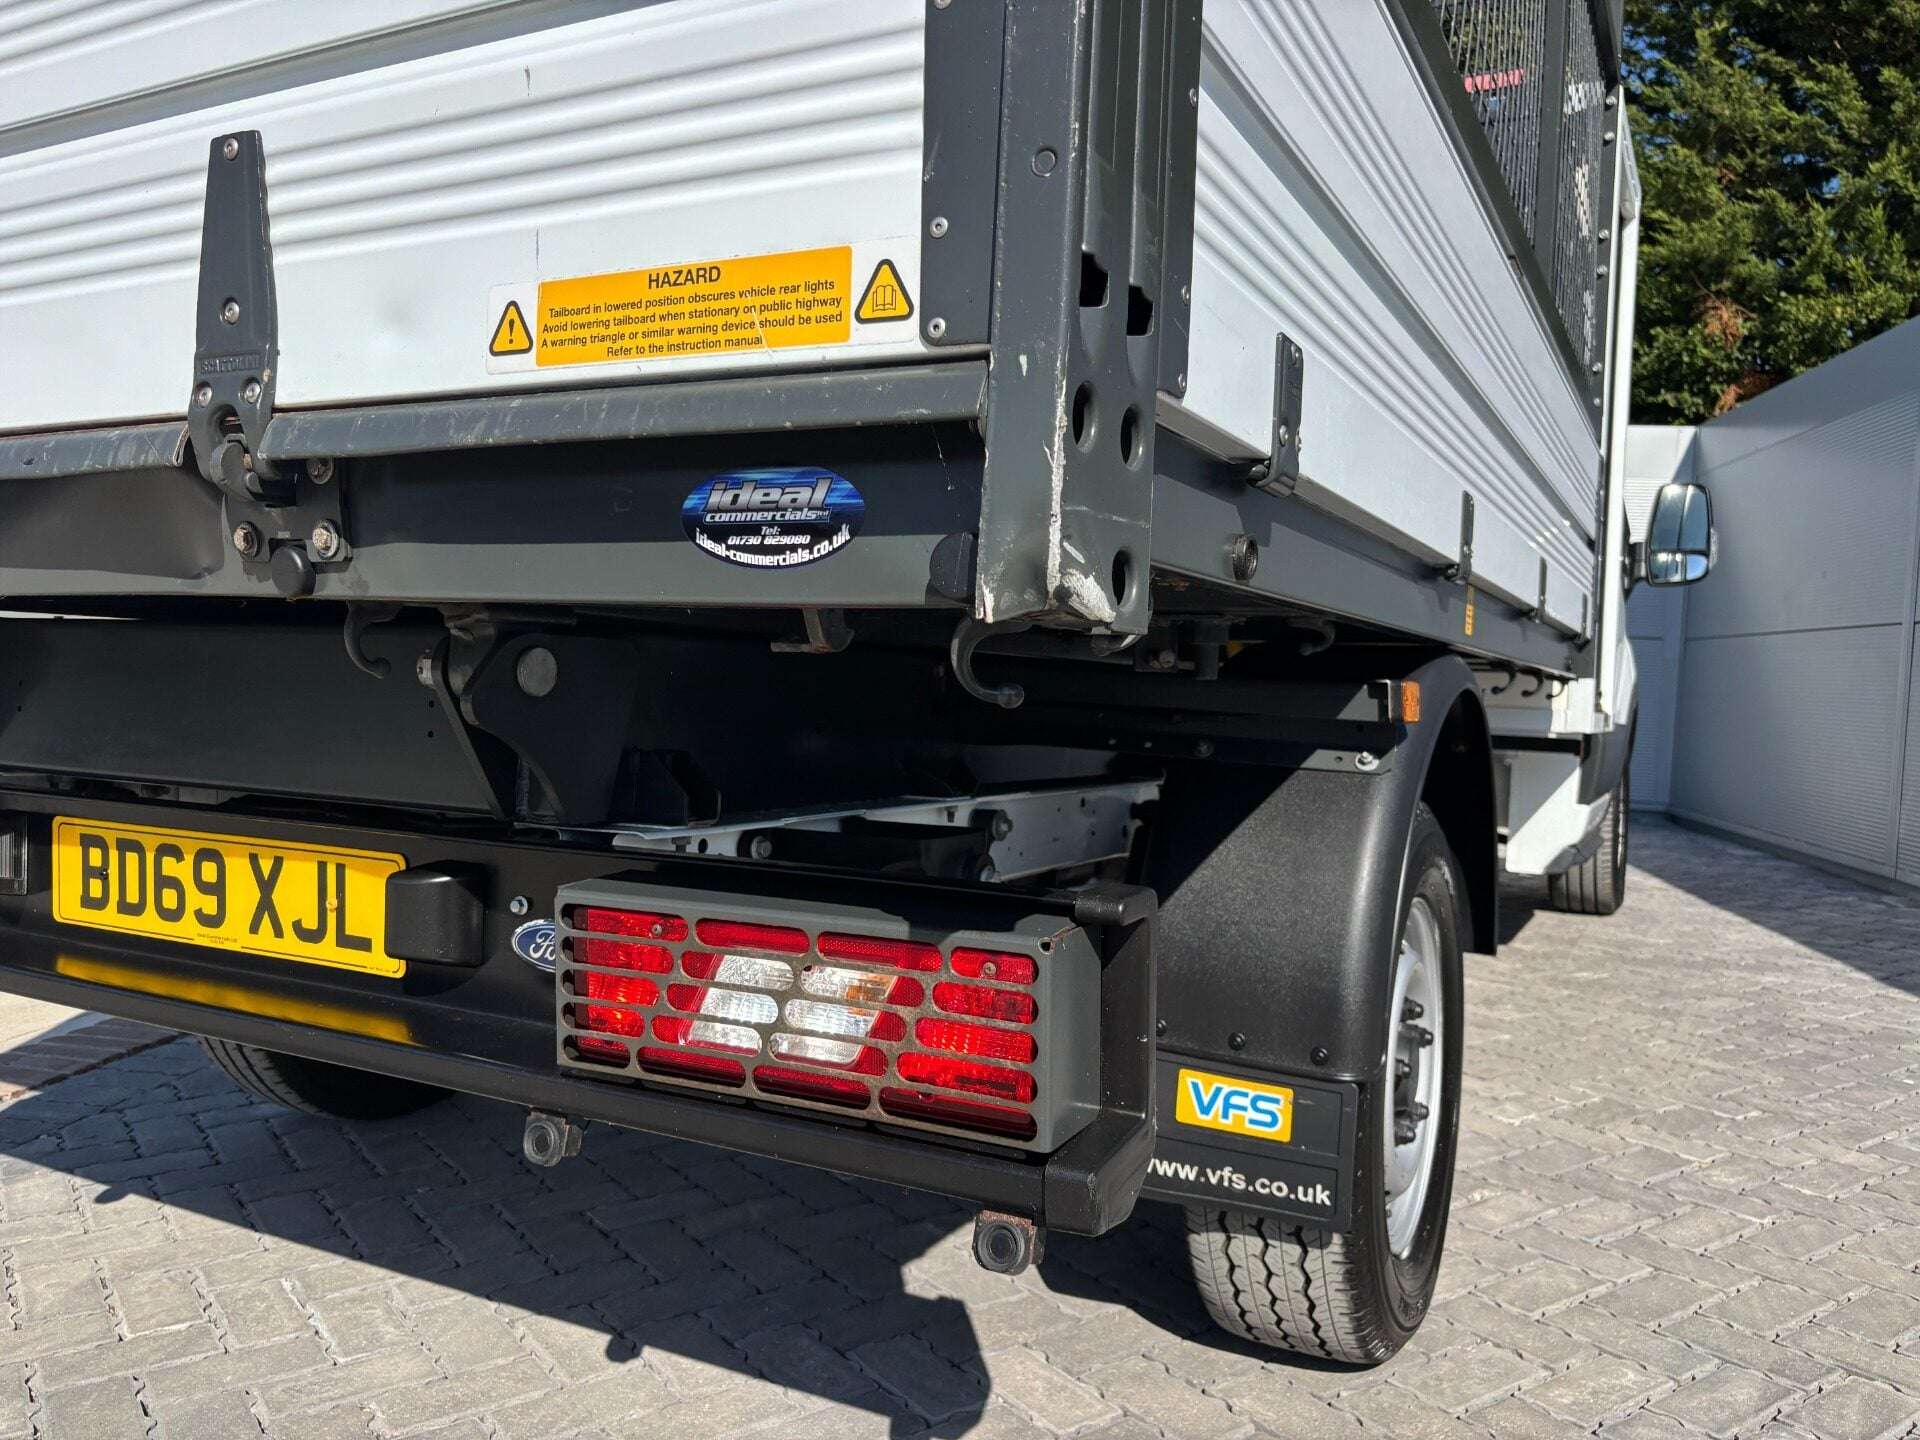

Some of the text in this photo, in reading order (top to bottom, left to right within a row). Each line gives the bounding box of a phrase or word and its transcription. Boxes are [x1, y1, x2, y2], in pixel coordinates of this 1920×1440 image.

[648, 265, 721, 290] HAZARD
[542, 297, 842, 334] Avoid lowering tailboard when stationary on public highway
[549, 280, 835, 318] Tailboard in lowered position obscures vehicle rear lights
[541, 311, 842, 348] A warning triangle or similar warning device should be used
[607, 335, 763, 357] Refer to the instruction manual
[704, 476, 833, 512] ideal
[704, 507, 817, 522] commercials
[760, 526, 781, 536] Tel:
[695, 523, 851, 566] ideal-commercials.co.uk
[727, 534, 811, 545] 01730 829080
[79, 832, 372, 953] BD69 XJL
[1188, 1079, 1282, 1130] VFS
